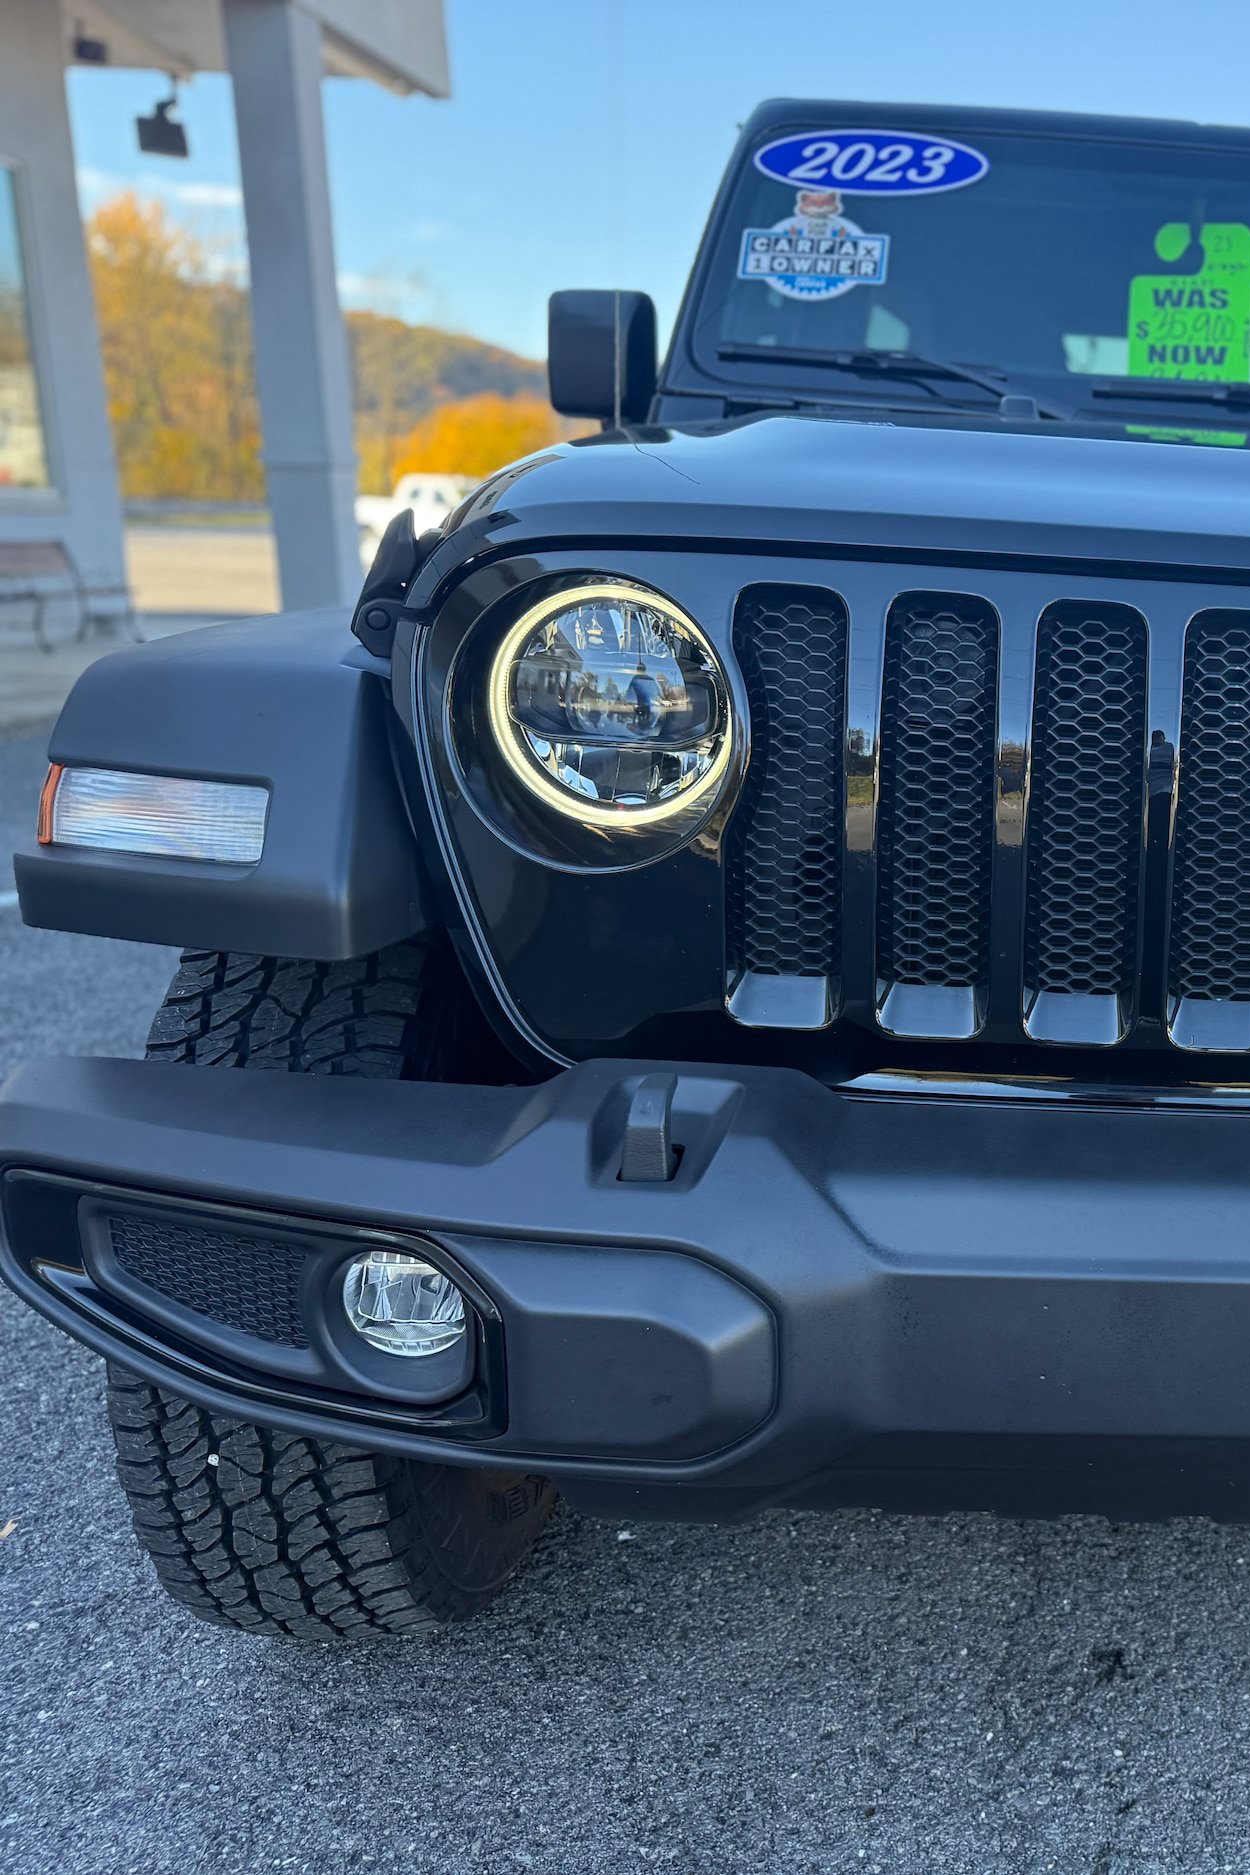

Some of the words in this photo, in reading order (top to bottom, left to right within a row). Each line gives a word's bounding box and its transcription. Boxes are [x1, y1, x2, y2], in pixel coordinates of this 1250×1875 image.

[787, 141, 955, 183] 2023
[753, 237, 877, 258] CARFAX
[1153, 288, 1229, 309] WAS
[1148, 344, 1228, 365] NOW
